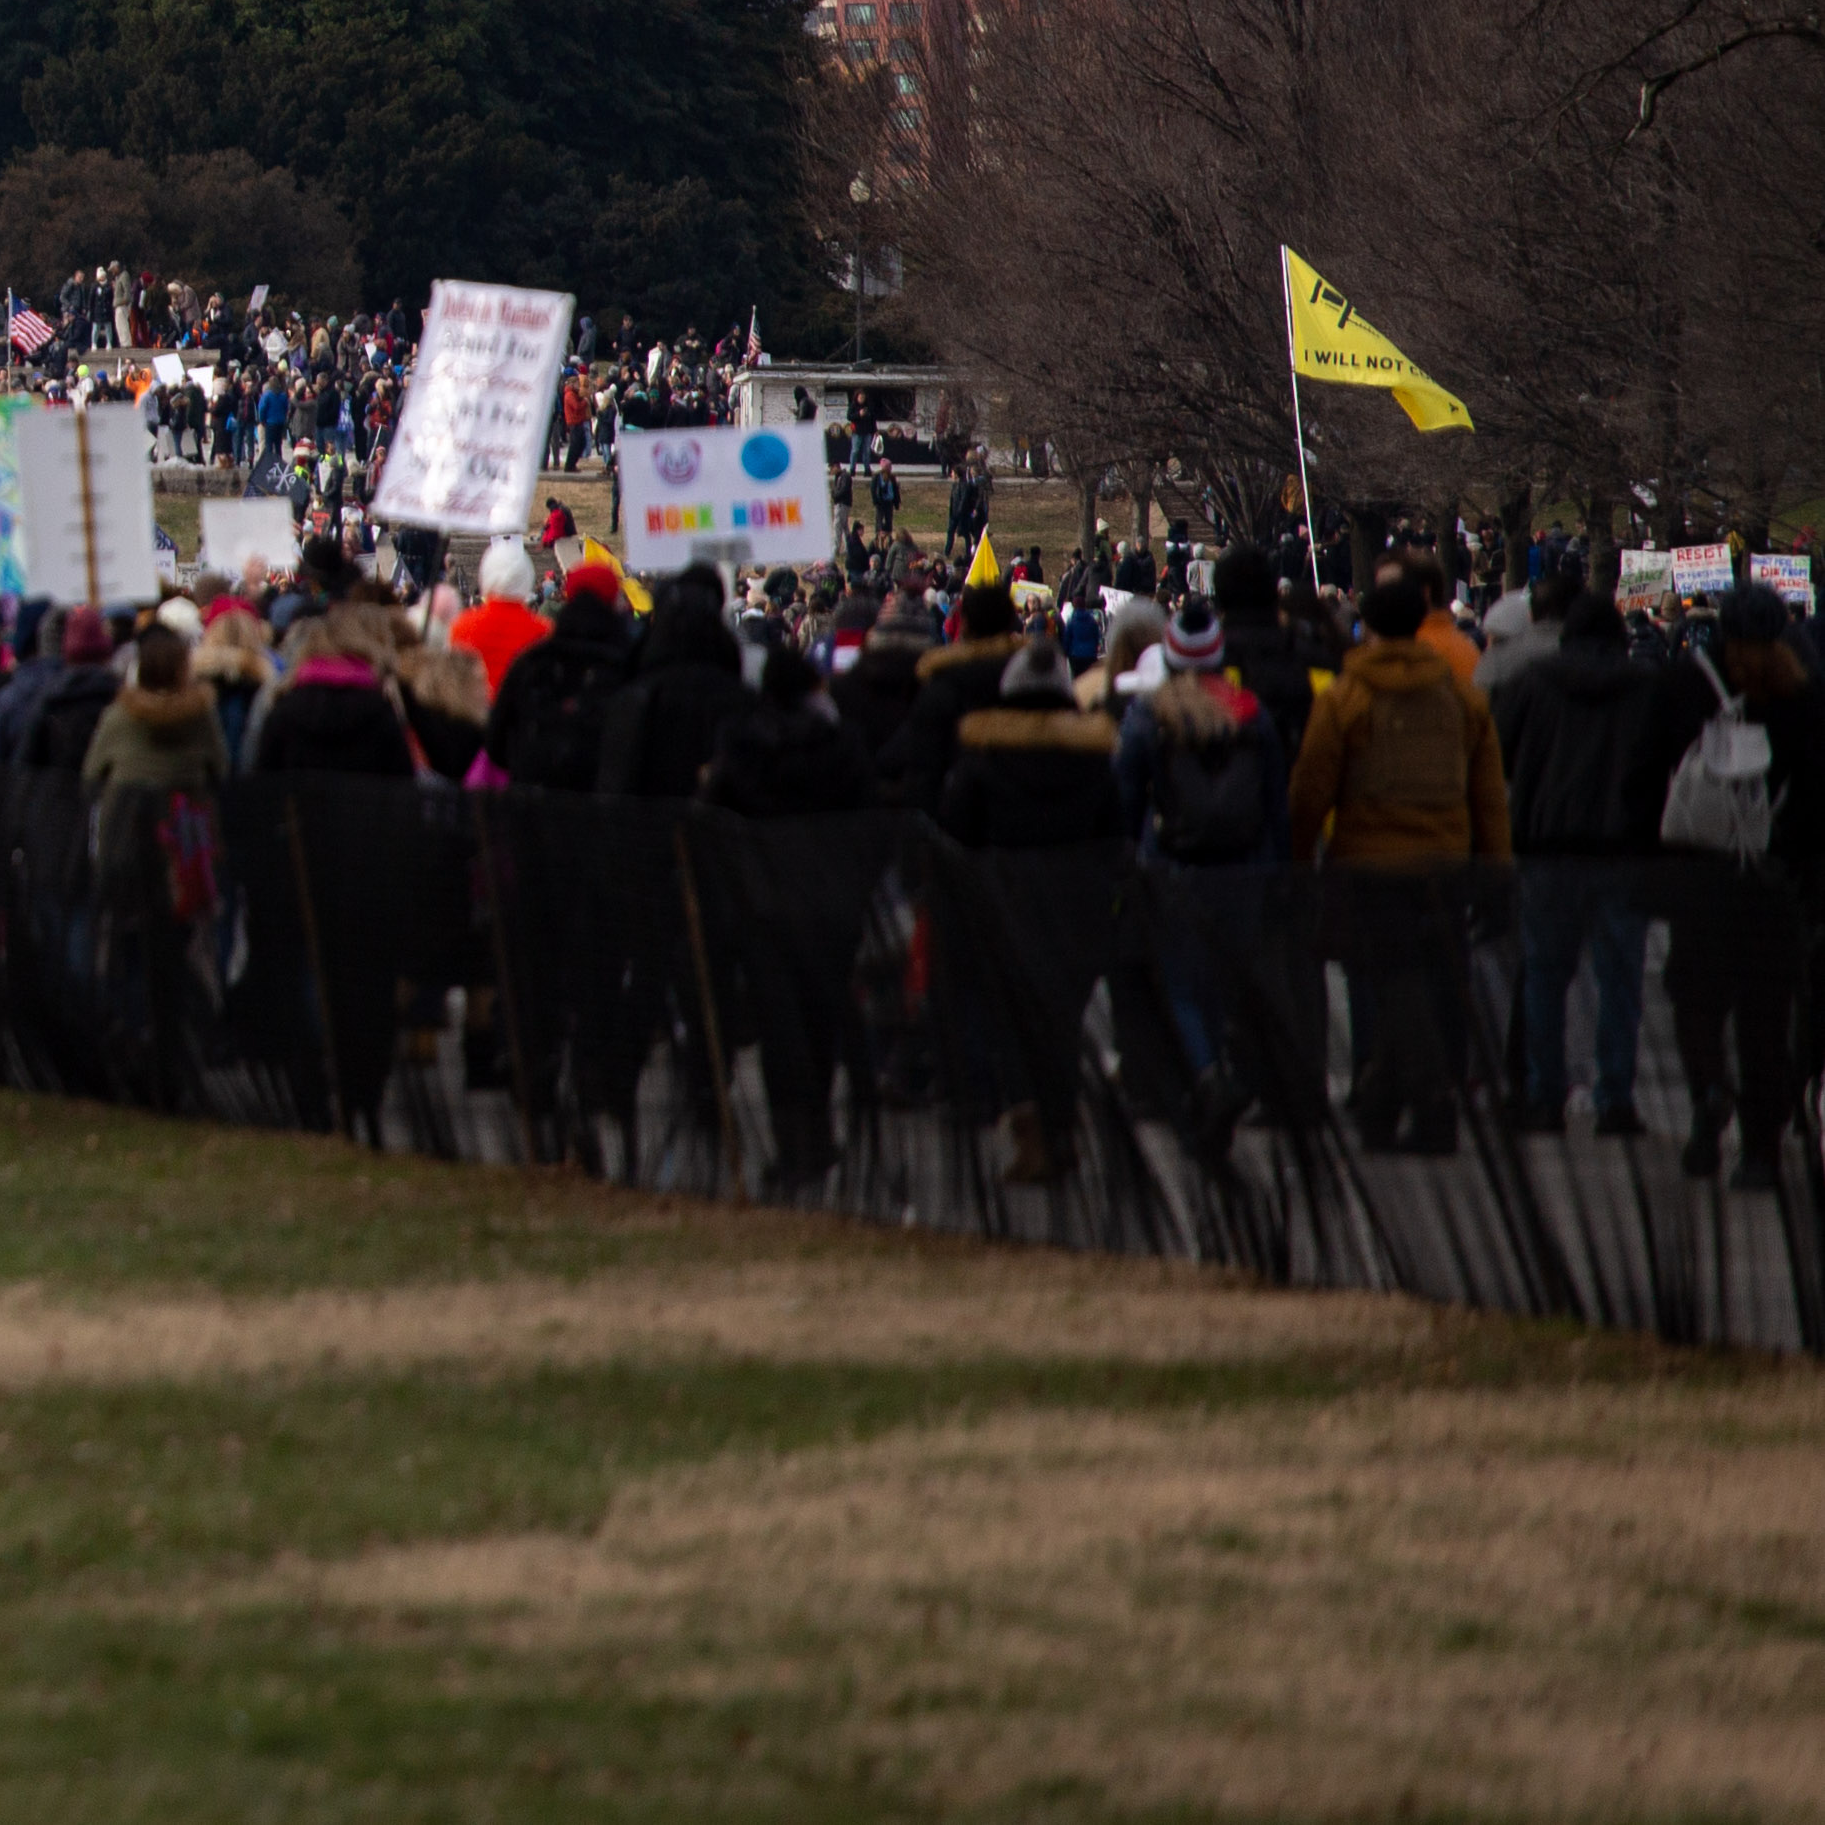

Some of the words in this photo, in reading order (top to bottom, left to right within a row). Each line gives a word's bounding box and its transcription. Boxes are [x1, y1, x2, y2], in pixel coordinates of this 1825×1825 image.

[1304, 349, 1309, 362] I
[1315, 349, 1361, 368] WILL
[1366, 355, 1404, 372] NOT
[647, 505, 713, 534] HONK
[733, 500, 801, 528] HONK
[1676, 544, 1724, 562] RESIST
[1629, 583, 1647, 595] NOT
